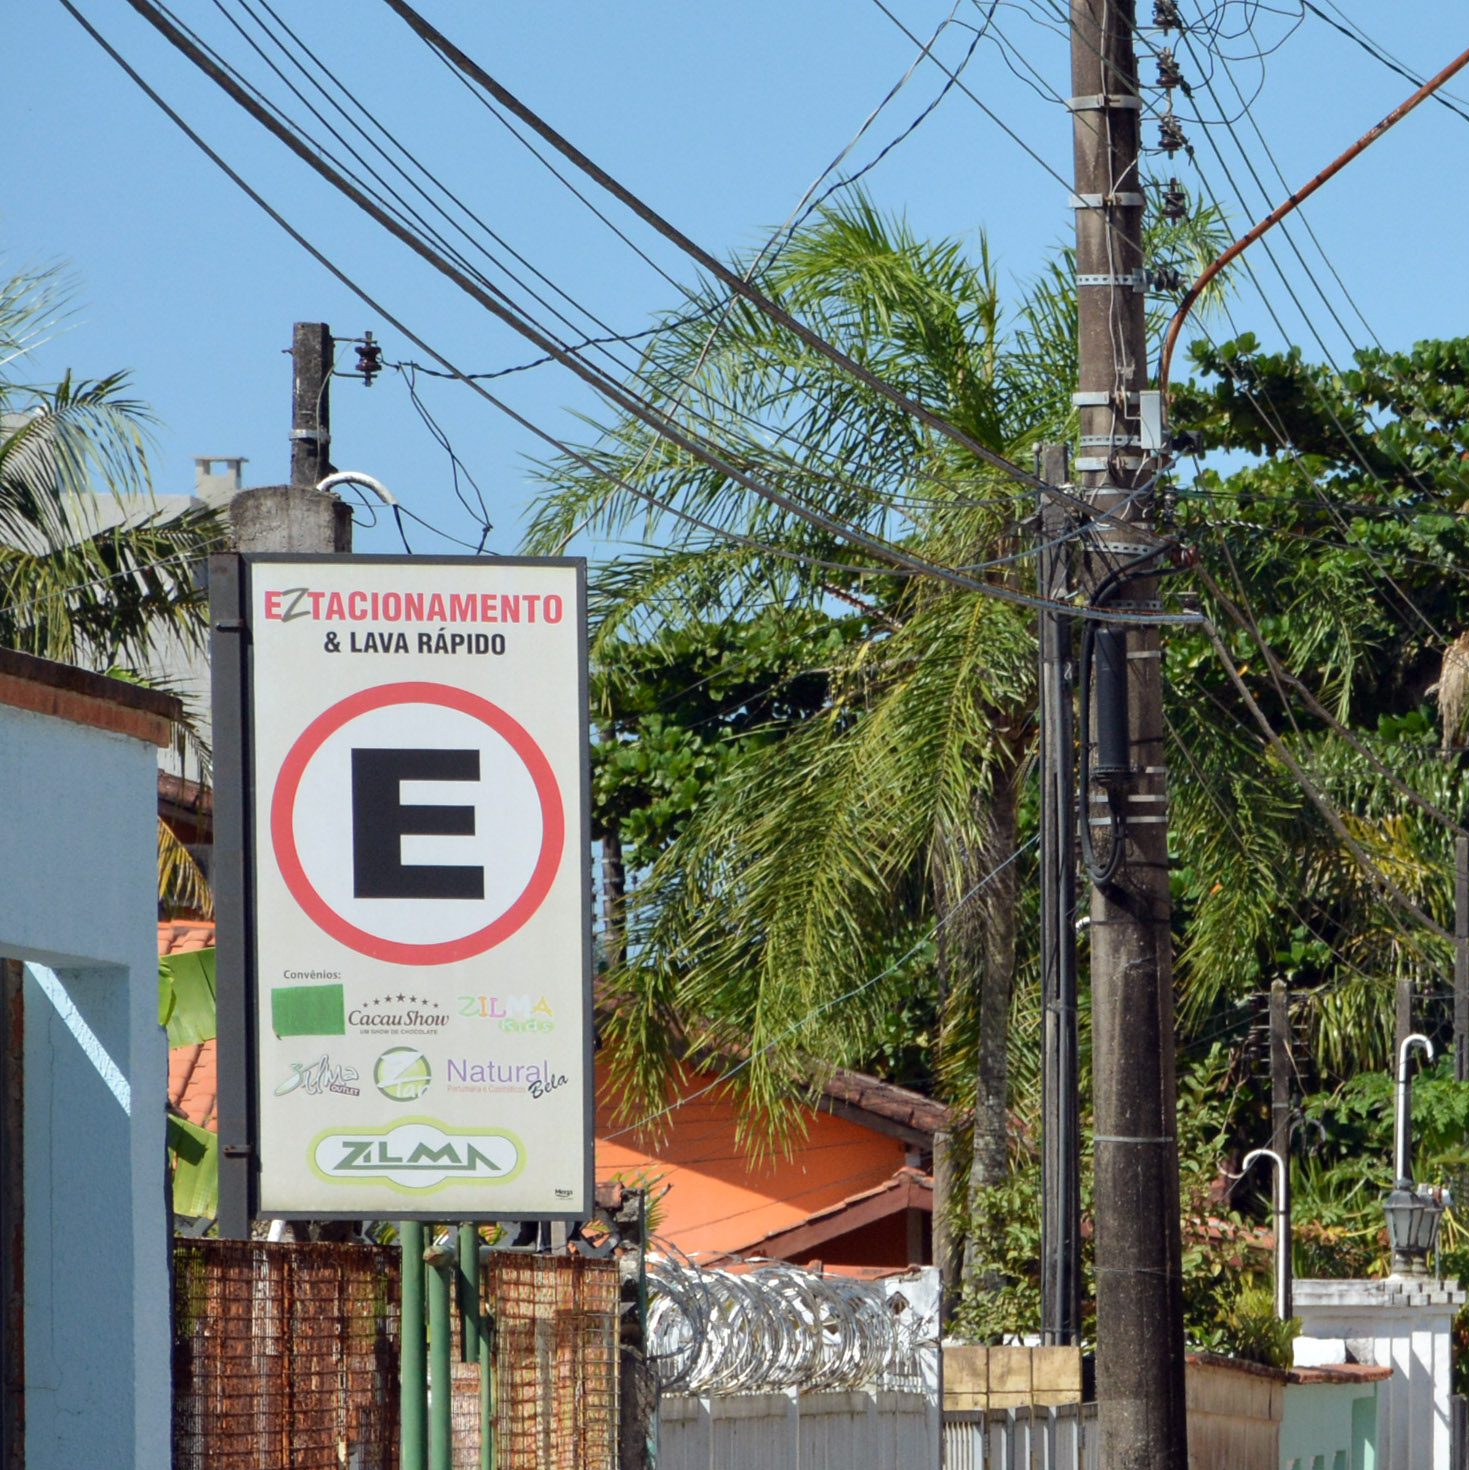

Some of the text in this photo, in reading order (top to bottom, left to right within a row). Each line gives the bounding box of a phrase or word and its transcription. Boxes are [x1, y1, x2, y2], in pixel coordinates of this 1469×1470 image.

[264, 588, 563, 624] EZTACIONAMENTO
[324, 627, 506, 656] & LAVA RÁPIDO
[351, 748, 485, 899] E
[283, 970, 341, 980] Convênios:
[348, 1010, 450, 1026] Cacau Show
[457, 995, 555, 1018] ZILMA
[447, 1059, 548, 1083] Natural
[528, 1073, 568, 1099] Bela
[333, 1141, 502, 1171] ZILMA
